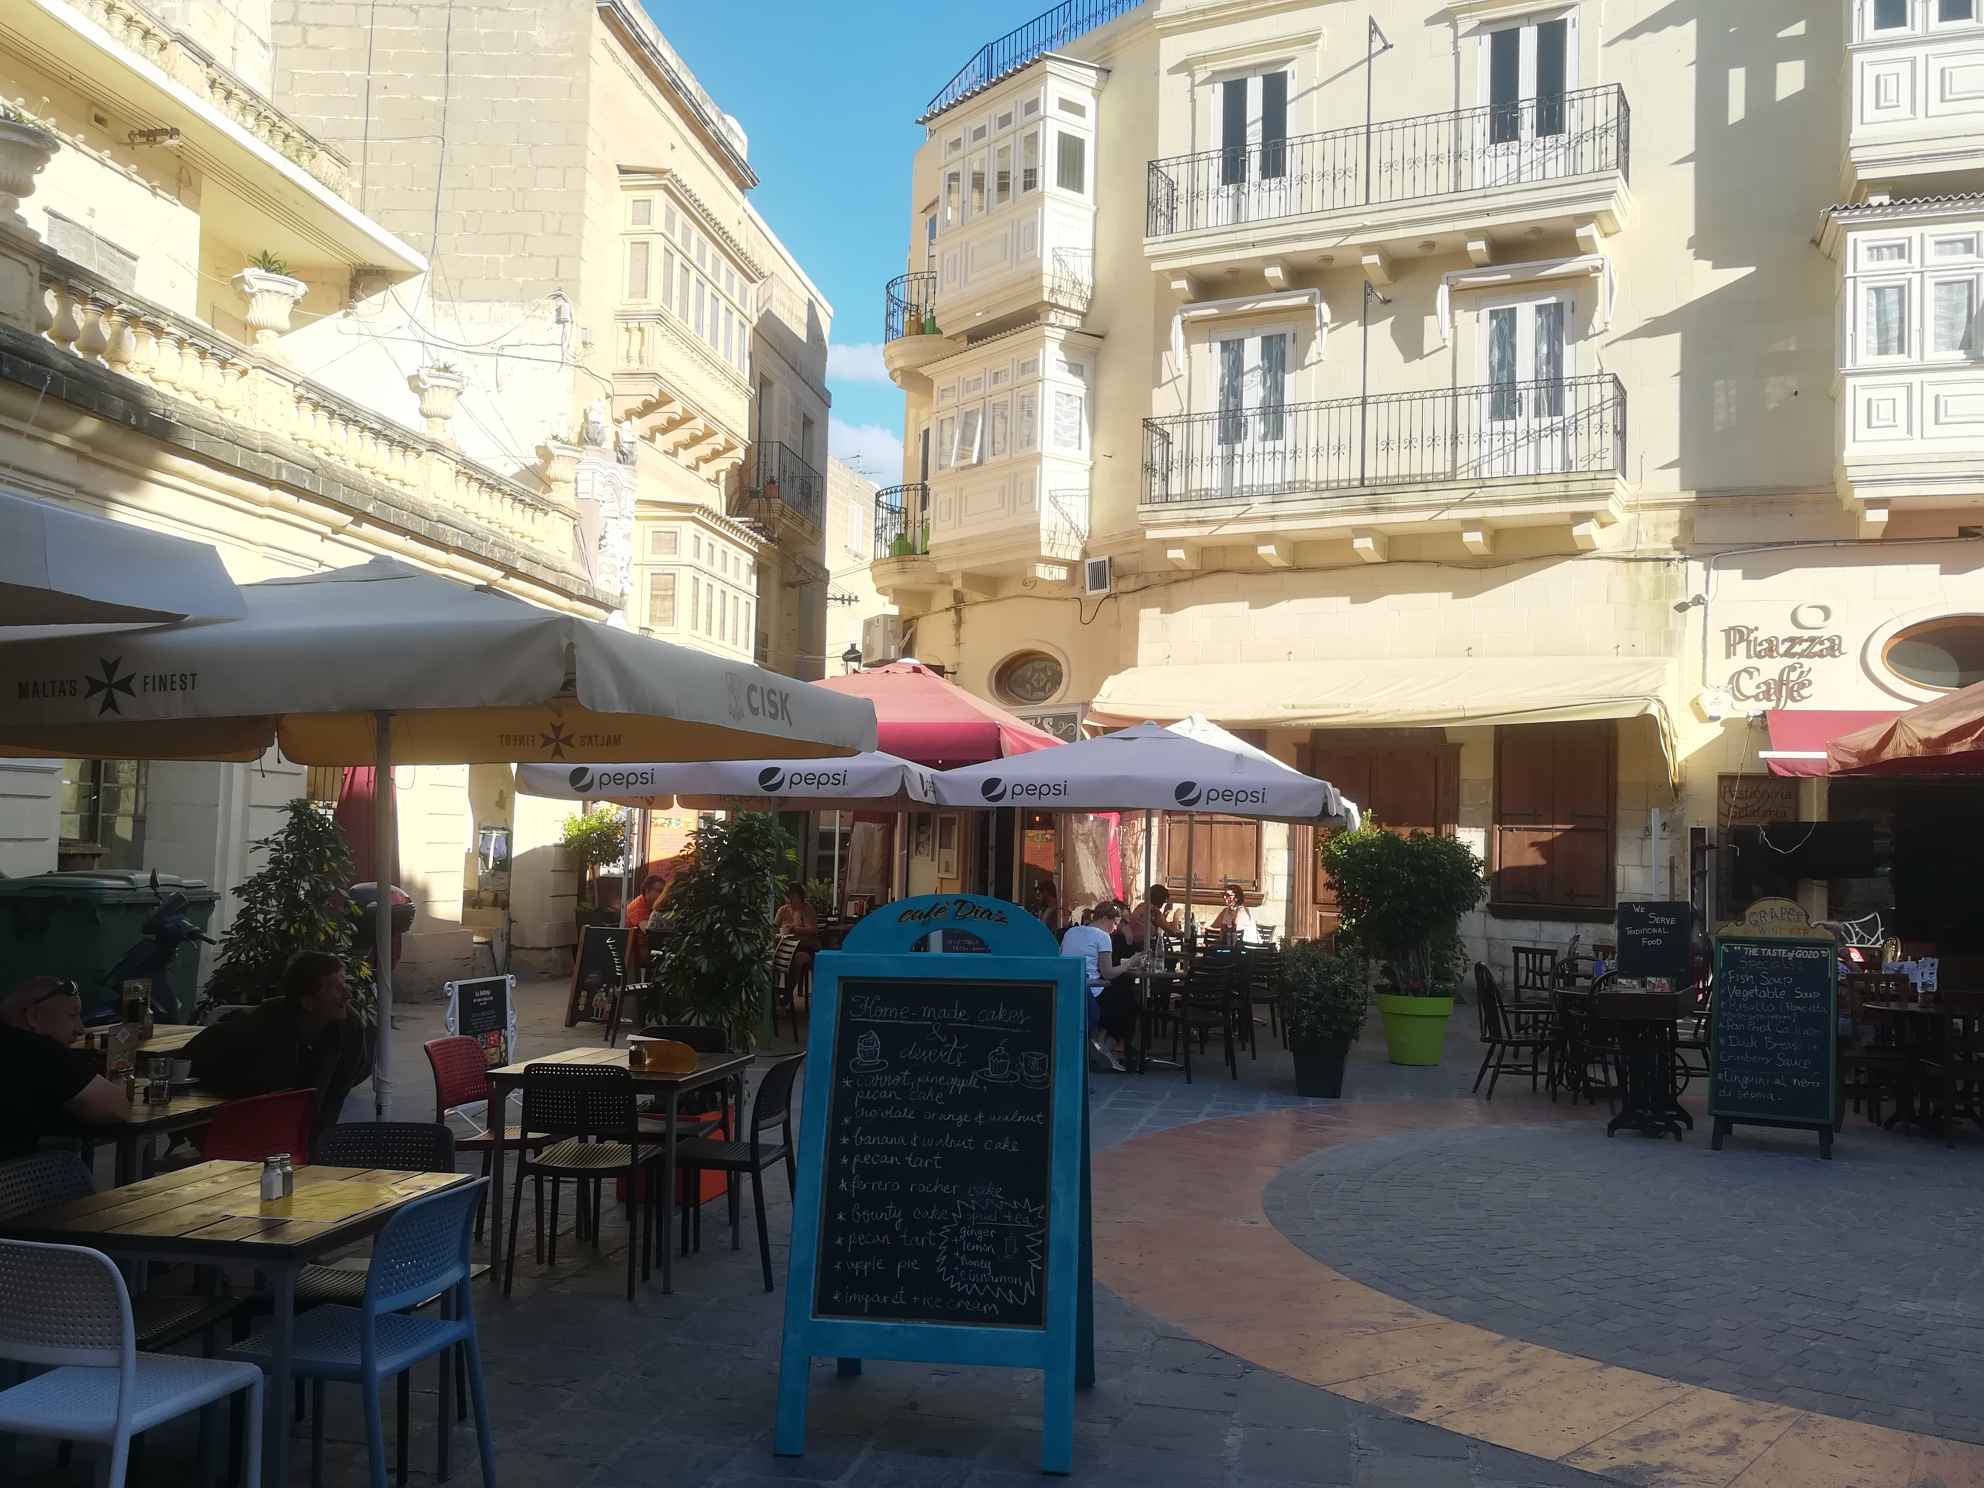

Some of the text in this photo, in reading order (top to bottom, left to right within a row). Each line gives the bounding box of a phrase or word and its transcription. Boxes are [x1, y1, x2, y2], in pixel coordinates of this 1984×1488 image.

[1720, 625, 1847, 659] Piazza
[17, 672, 199, 700] MALTA'S FINEST
[1728, 662, 1813, 711] Café
[746, 682, 793, 728] CISK
[599, 768, 655, 790] pepsi
[789, 769, 848, 791] pepsi
[1011, 780, 1068, 800] pepsi
[1206, 787, 1267, 807] pepsi
[1744, 947, 1760, 957] THE
[1761, 948, 1785, 958] TASTE
[1796, 950, 1819, 959] GOZO
[851, 1151, 944, 1174] pecan tart
